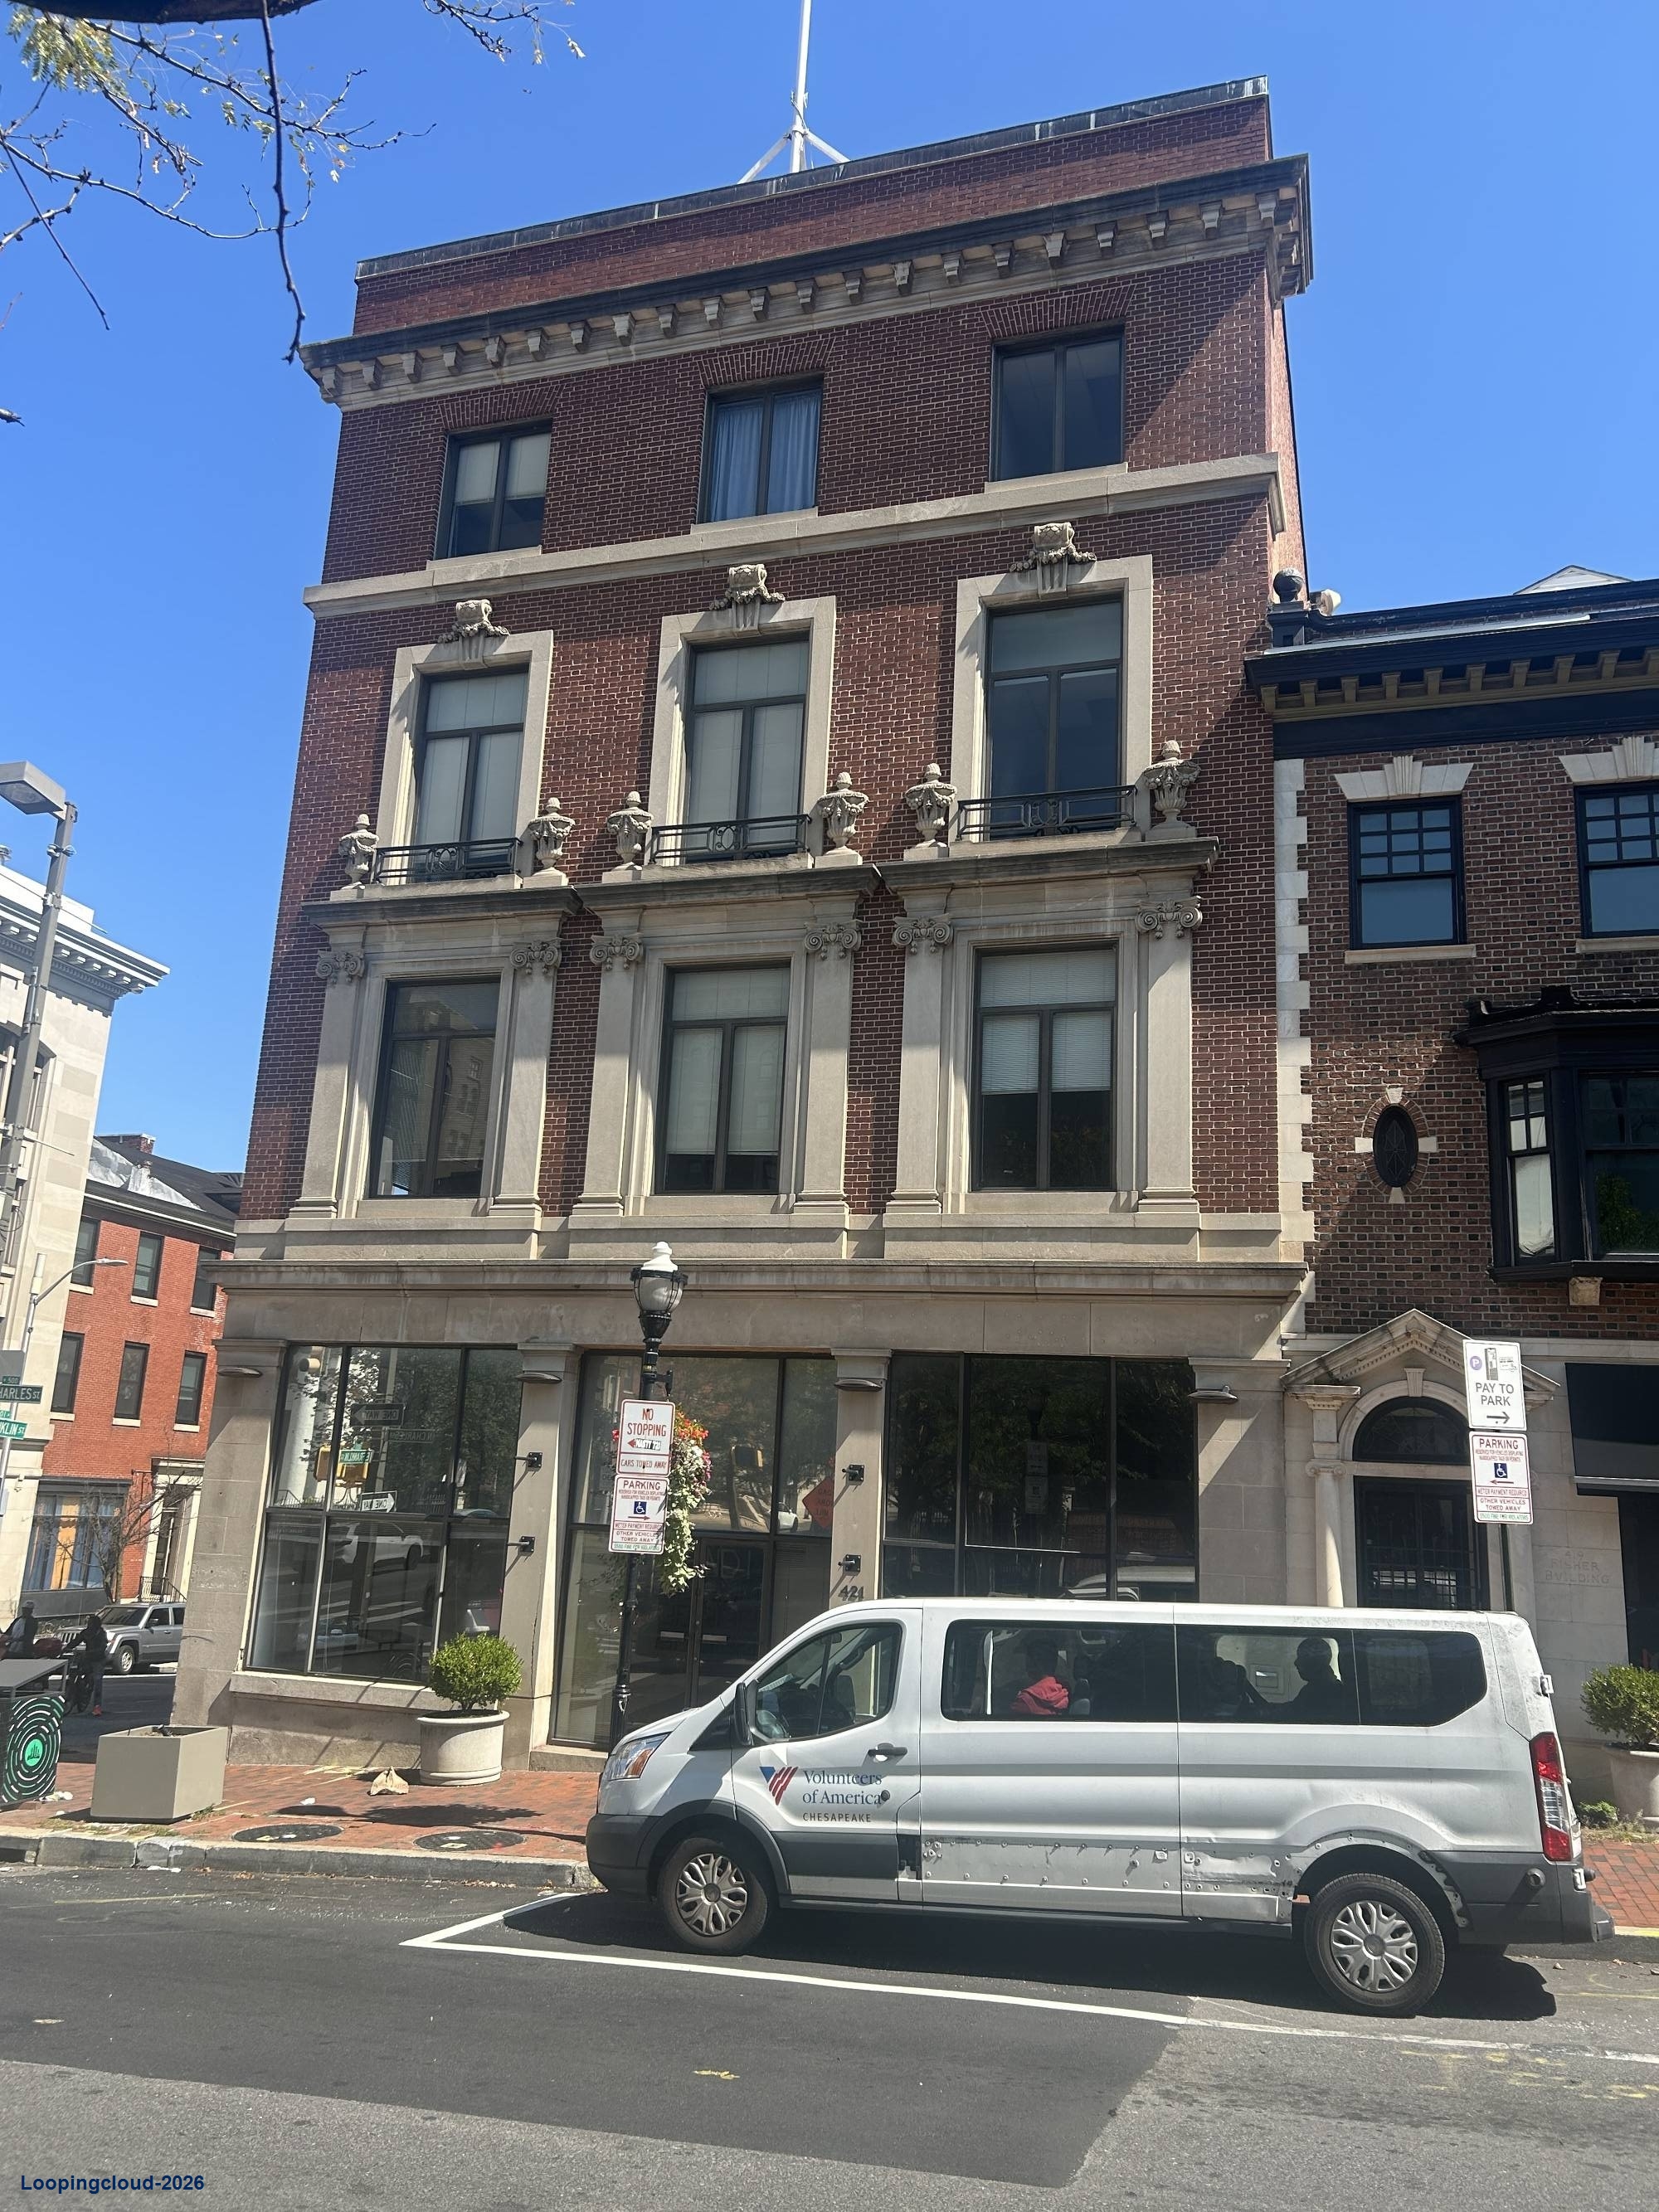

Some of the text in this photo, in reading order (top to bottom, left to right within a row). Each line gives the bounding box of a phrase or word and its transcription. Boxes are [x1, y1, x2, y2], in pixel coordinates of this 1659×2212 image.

[1476, 1382, 1515, 1394] PAY TO
[1481, 1394, 1511, 1406] PARK
[642, 1407, 654, 1421] NO
[627, 1422, 667, 1437] STOPPING
[1479, 1438, 1519, 1450] PARKING
[636, 1460, 653, 1468] TOWED
[654, 1461, 667, 1469] AWAY
[623, 1480, 661, 1490] PARKING
[1491, 1488, 1508, 1496] PAYMENT
[803, 1770, 882, 1785] Volunteers
[802, 1789, 881, 1805] of America
[802, 1812, 872, 1823] CHESAPEAKE
